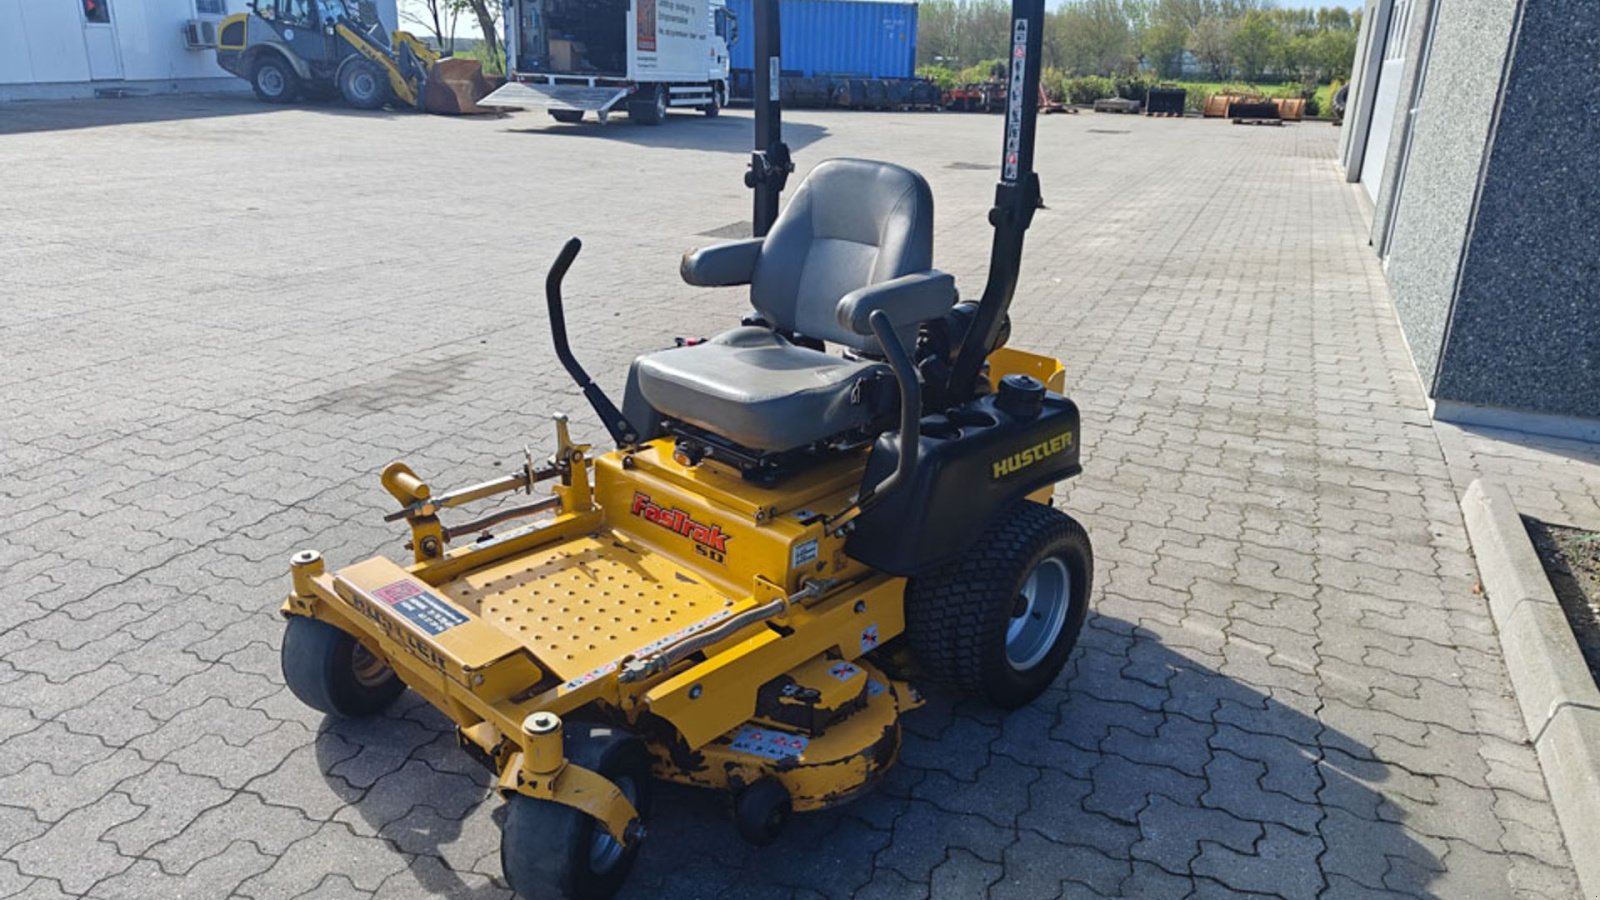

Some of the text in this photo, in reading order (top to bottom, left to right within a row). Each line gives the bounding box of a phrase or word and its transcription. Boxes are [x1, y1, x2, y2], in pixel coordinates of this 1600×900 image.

[993, 431, 1073, 478] HUSTLER
[631, 491, 732, 554] FasTrak
[695, 543, 724, 564] SD
